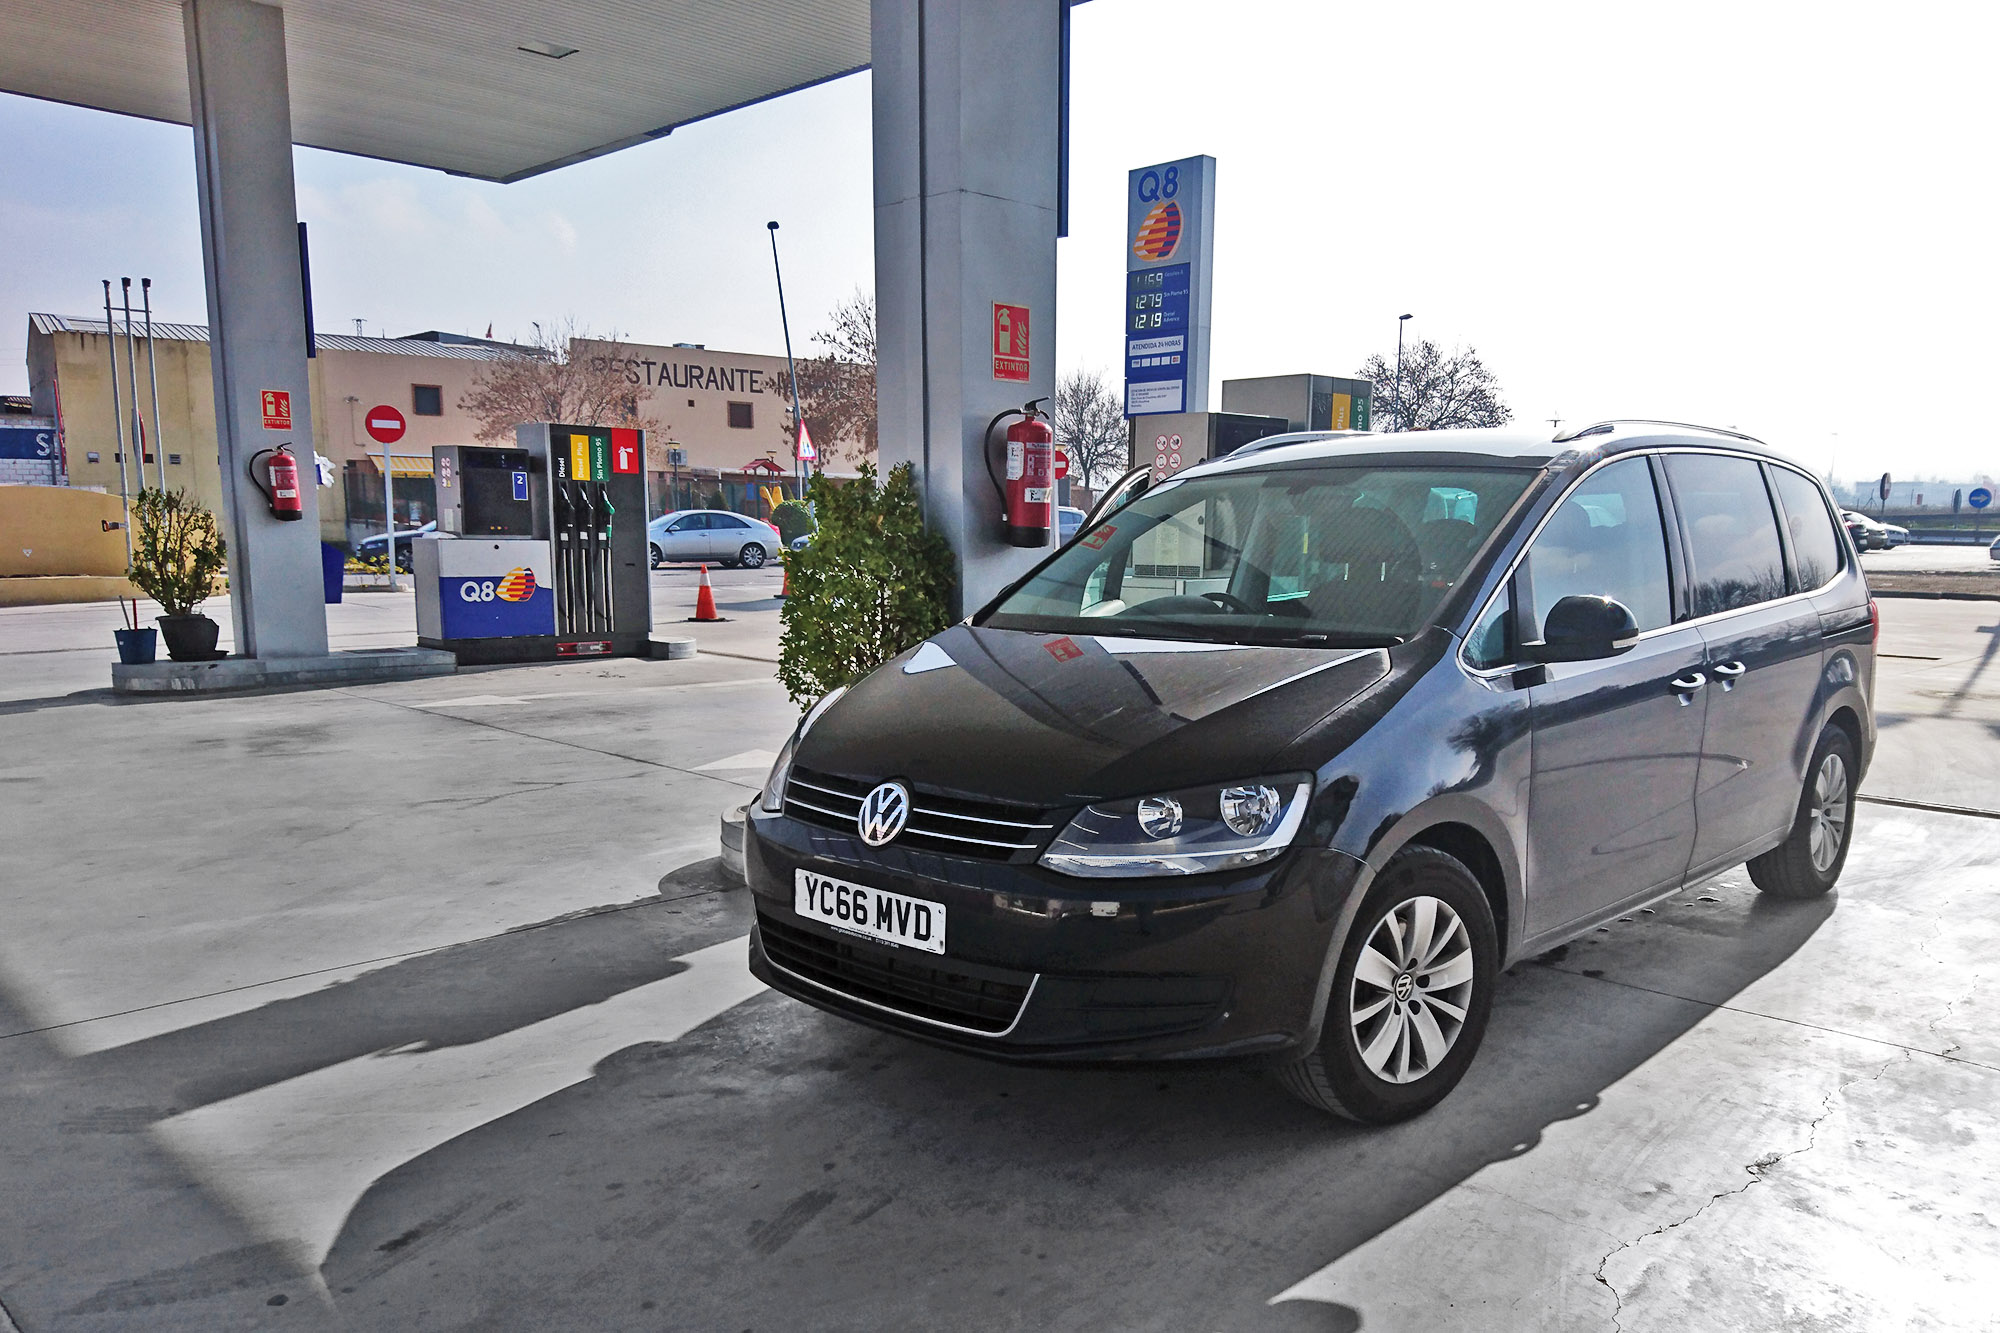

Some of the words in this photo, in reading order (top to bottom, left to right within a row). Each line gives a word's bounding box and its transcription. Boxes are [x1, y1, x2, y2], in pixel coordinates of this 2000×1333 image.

[1138, 166, 1178, 203] Q8
[1132, 342, 1157, 350] ATENDIDA
[995, 360, 1028, 373] EXTINTOR
[1357, 398, 1364, 412] 95
[1337, 406, 1345, 430] Plus
[595, 437, 602, 446] 95
[558, 457, 566, 478] Diesel
[577, 458, 585, 478] Diesel
[516, 475, 524, 485] 2
[460, 581, 495, 602] Q8
[804, 875, 868, 926] YC66
[876, 894, 932, 942] MVD
